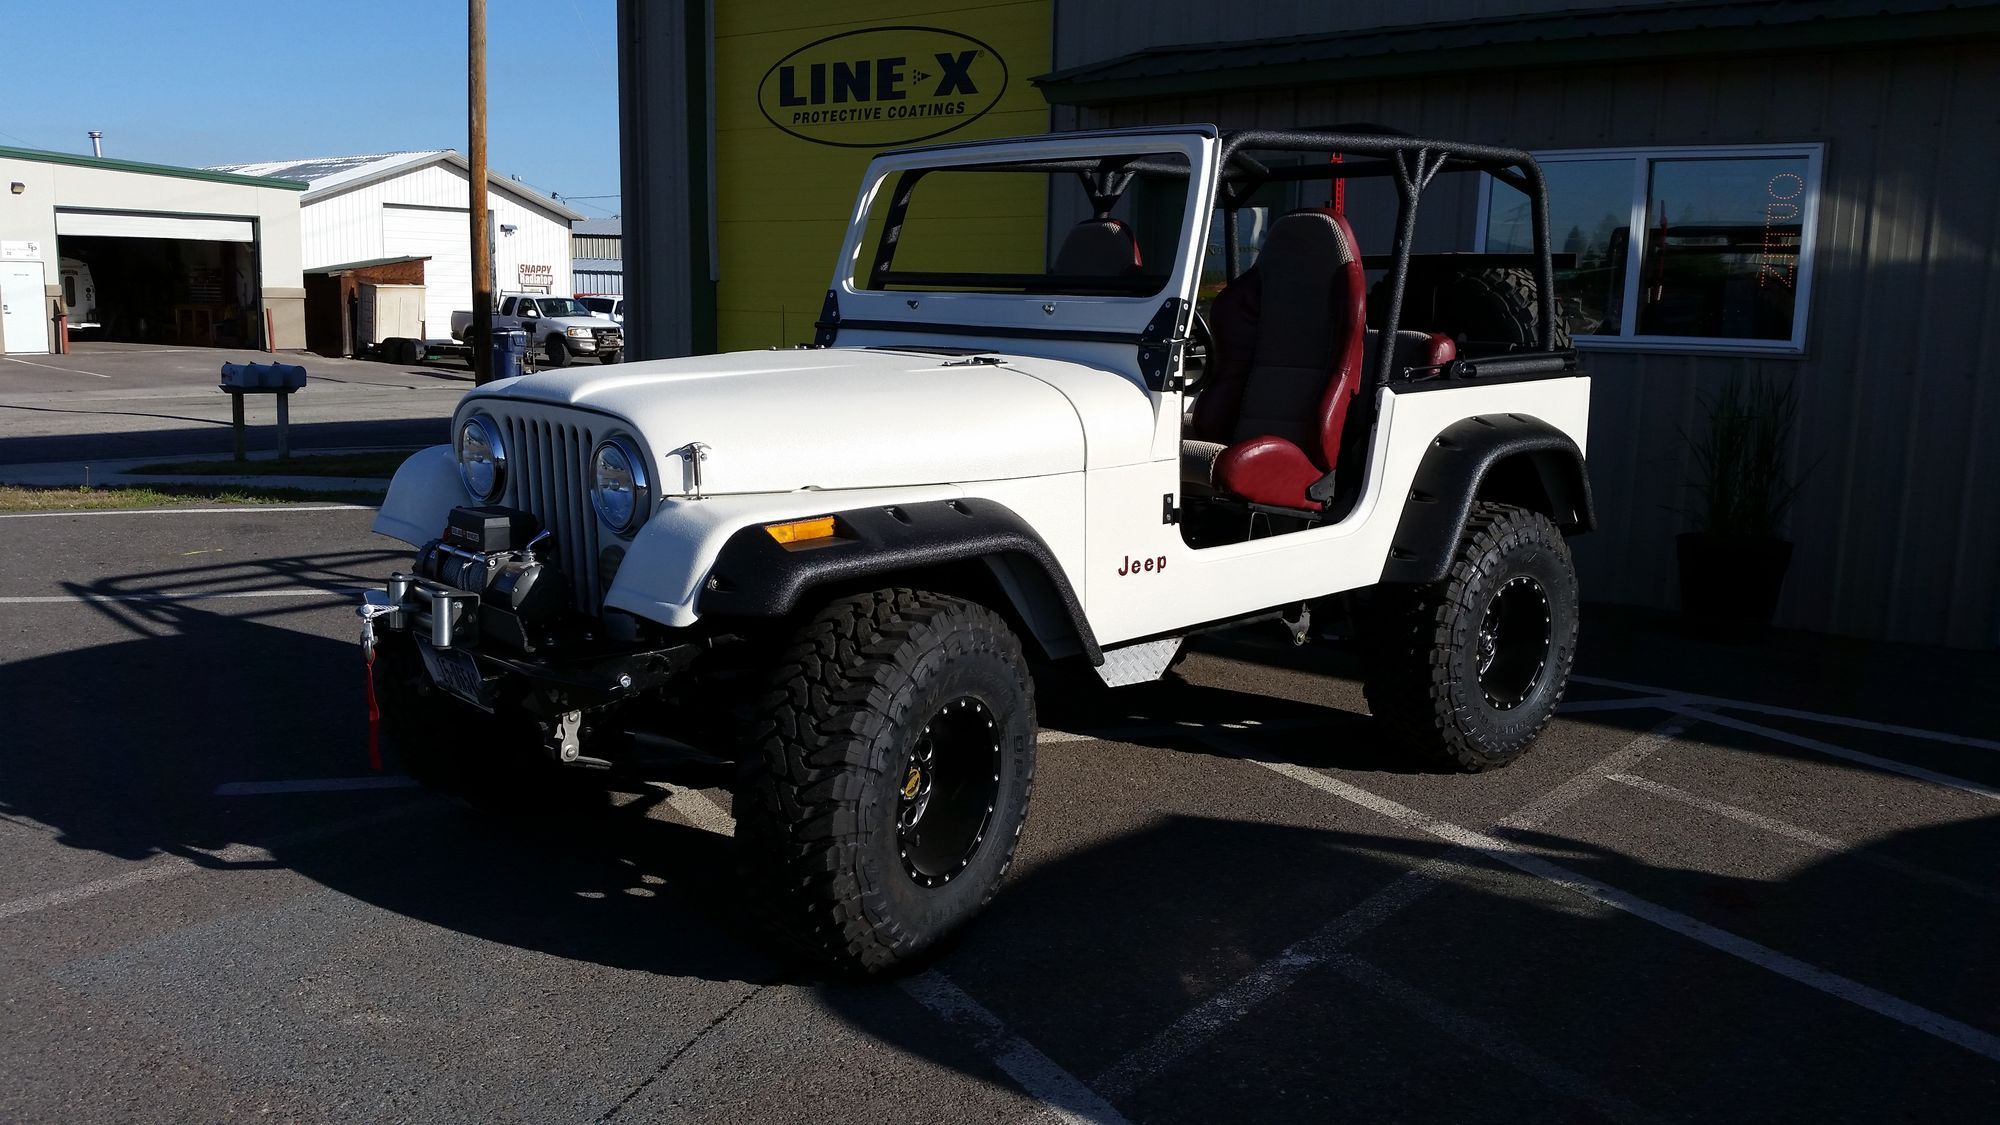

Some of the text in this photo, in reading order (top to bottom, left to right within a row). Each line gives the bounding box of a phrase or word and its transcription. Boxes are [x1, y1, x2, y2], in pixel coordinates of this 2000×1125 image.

[793, 101, 966, 125] PROTECTIVE COATINGS
[1761, 173, 1803, 288] OPEN
[520, 264, 552, 273] SNAPPY
[520, 274, 552, 284] Radiator
[1118, 555, 1167, 577] Jeep
